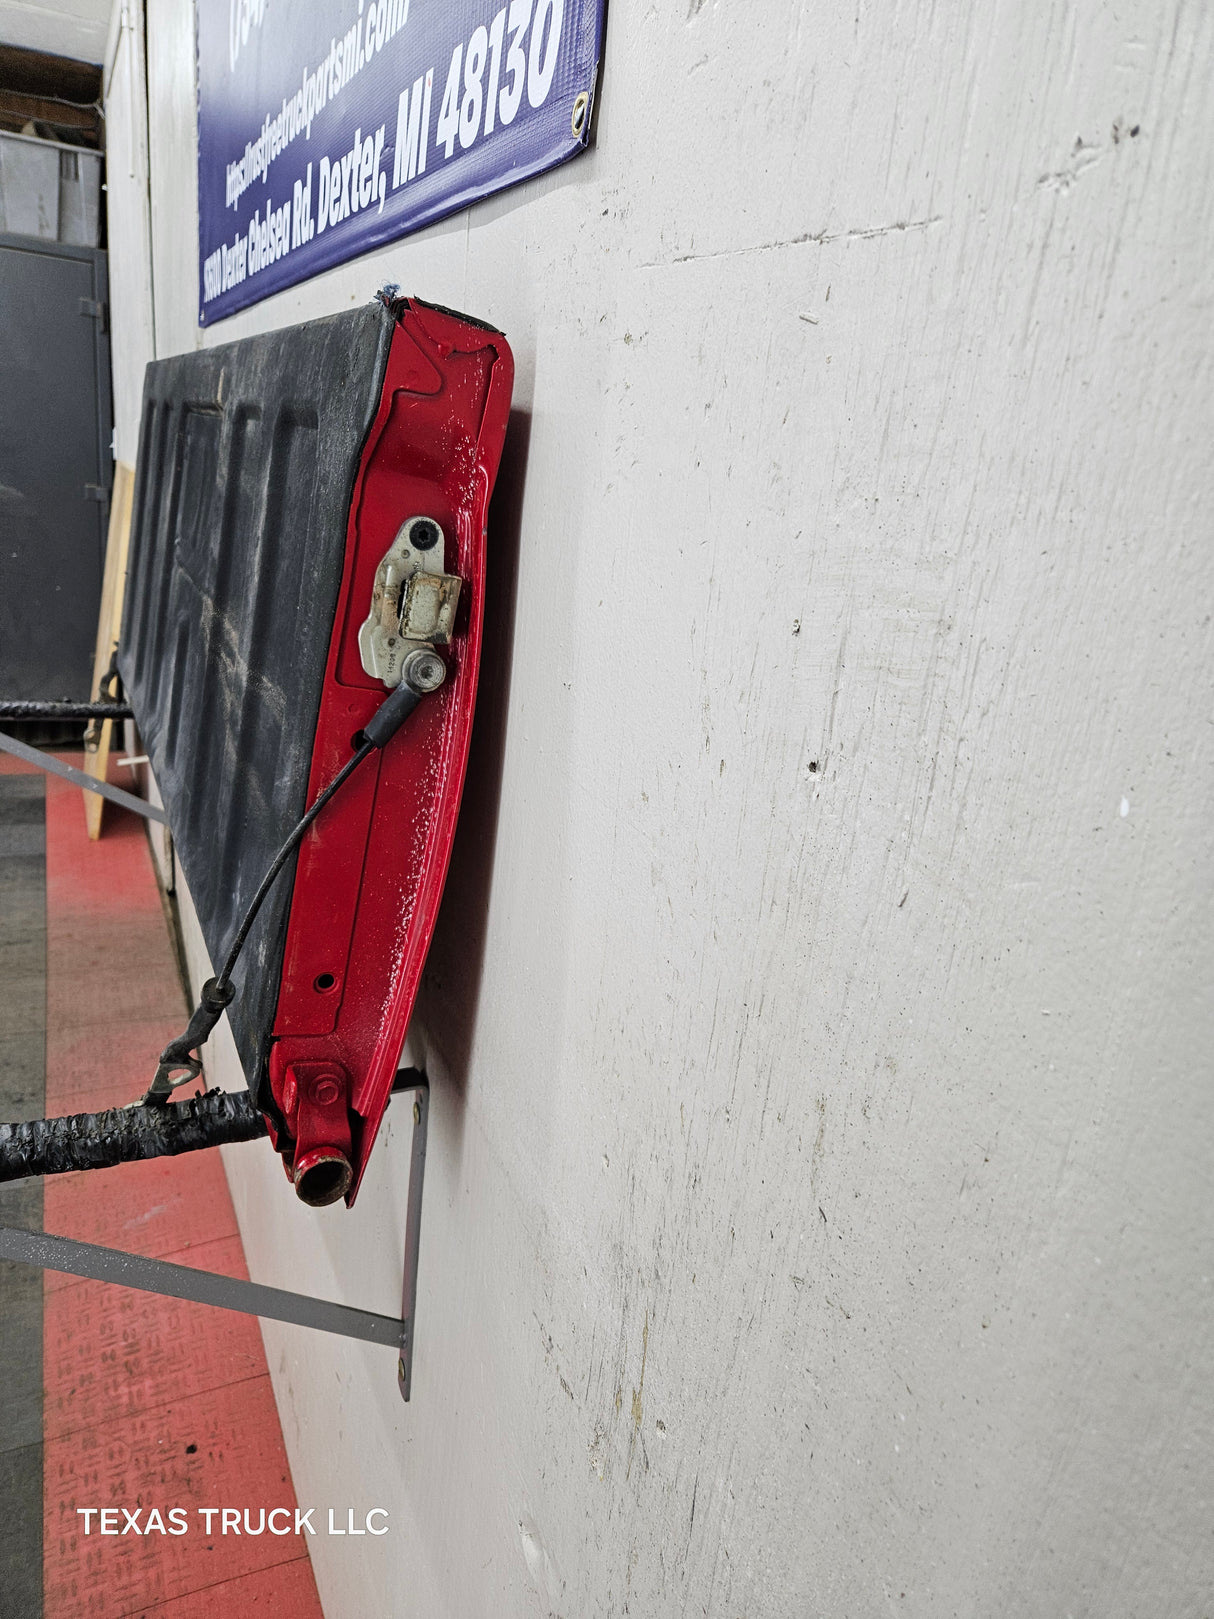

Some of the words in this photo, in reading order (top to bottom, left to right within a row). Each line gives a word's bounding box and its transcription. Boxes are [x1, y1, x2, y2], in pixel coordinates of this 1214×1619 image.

[221, 232, 248, 293] Dexter
[248, 198, 291, 276] Chelsea
[291, 161, 315, 250] Rd.
[317, 123, 386, 234] Dexter,
[392, 67, 434, 190] MI
[436, 0, 564, 160] 48130
